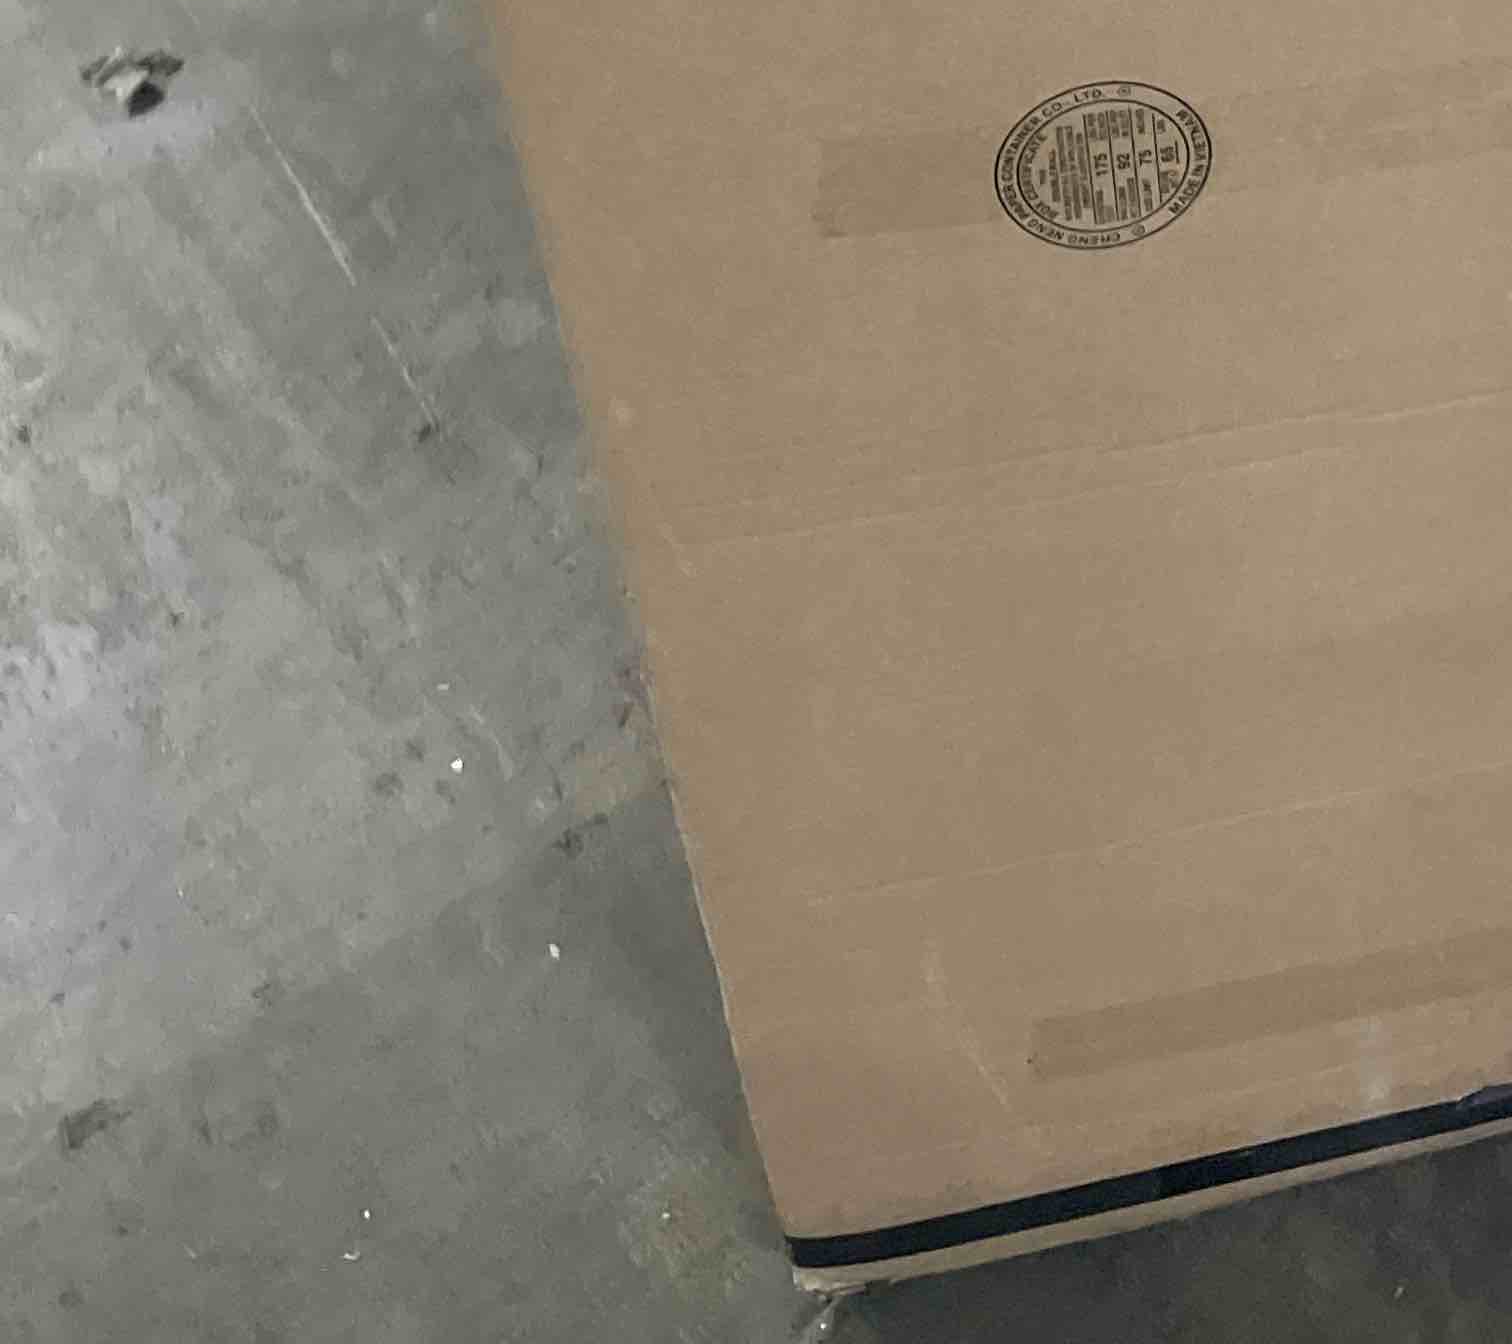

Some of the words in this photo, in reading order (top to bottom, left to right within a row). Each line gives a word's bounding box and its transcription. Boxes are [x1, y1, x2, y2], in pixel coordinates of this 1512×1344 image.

[1001, 115, 1042, 182] CONTAINER
[1175, 108, 1207, 161] VIETNAM
[1094, 153, 1109, 177] 175
[1138, 148, 1153, 168] 75
[1191, 163, 1205, 177] IN
[1003, 183, 1030, 221] PAPER
[1168, 178, 1200, 215] MADE
